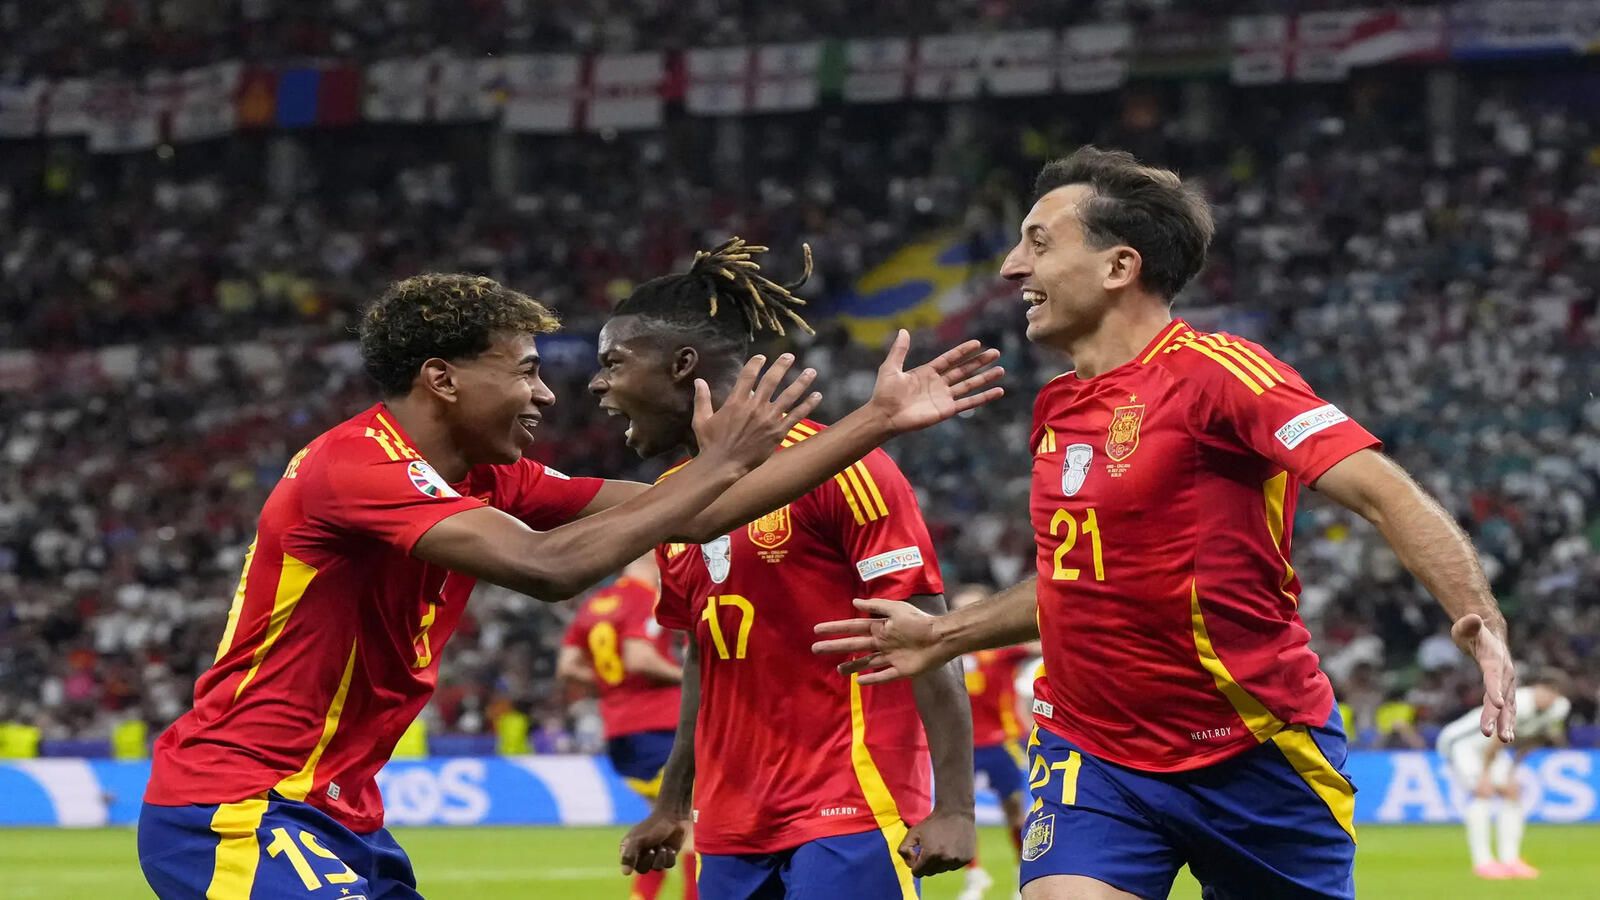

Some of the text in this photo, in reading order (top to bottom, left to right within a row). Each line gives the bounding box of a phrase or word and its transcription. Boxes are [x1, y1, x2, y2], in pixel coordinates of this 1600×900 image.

[1050, 508, 1105, 581] 21
[587, 620, 625, 686] 8
[702, 594, 755, 660] 17
[1190, 726, 1231, 740] HEAT.RDY
